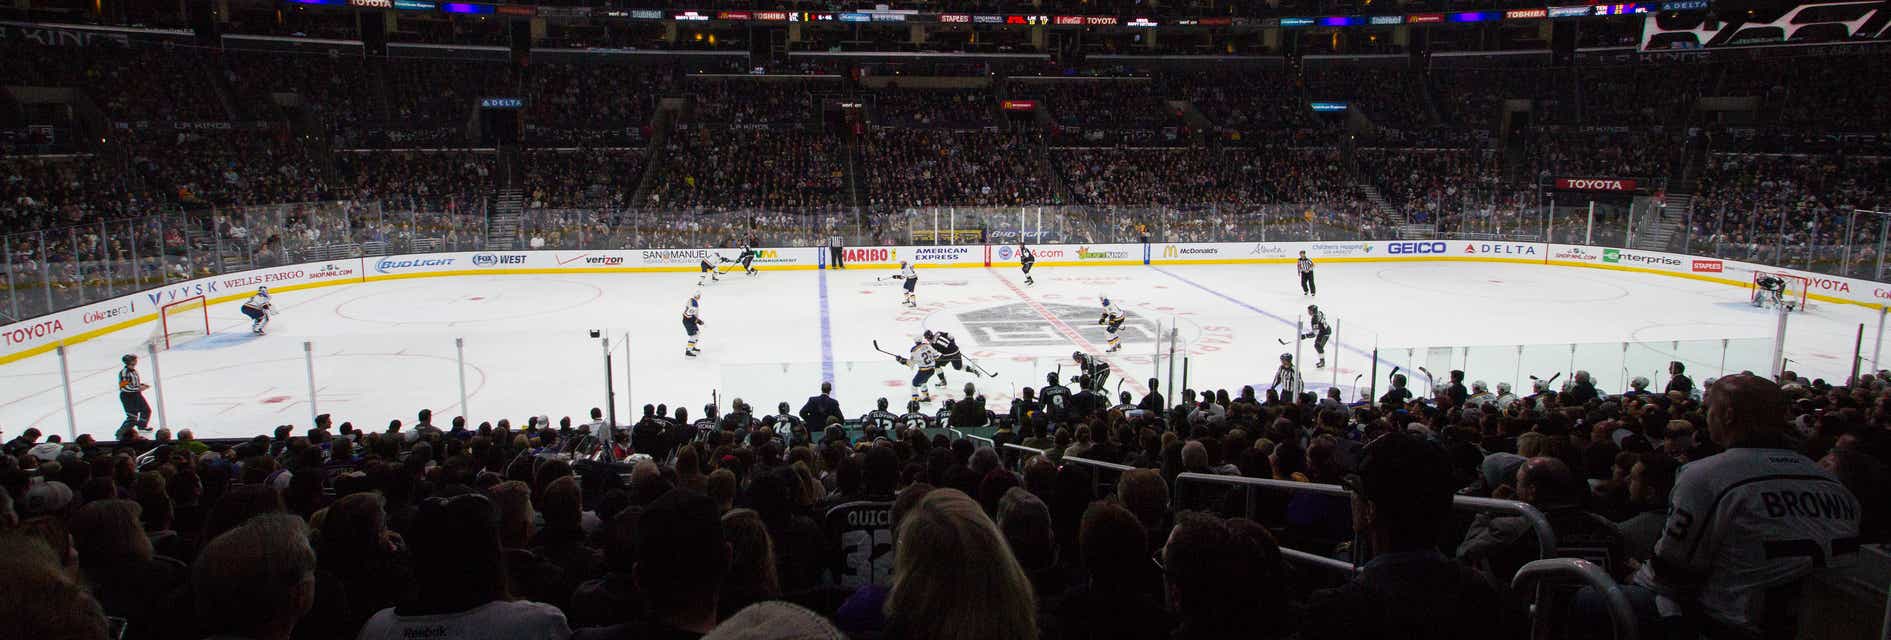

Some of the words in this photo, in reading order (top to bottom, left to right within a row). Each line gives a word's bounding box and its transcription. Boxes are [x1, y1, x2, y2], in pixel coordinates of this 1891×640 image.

[1567, 179, 1622, 190] TOYOTA
[1181, 247, 1218, 255] McDonald's
[1388, 242, 1447, 254] GEICO
[1482, 245, 1536, 255] DELTA
[500, 255, 527, 264] WEST
[586, 256, 624, 265] verizon
[643, 251, 662, 259] SAN
[841, 249, 888, 262] HARIBO
[224, 275, 263, 290] WELLS
[265, 270, 304, 284] FARGO
[2, 319, 64, 346] TOYOTA
[1761, 491, 1857, 522] BROWN
